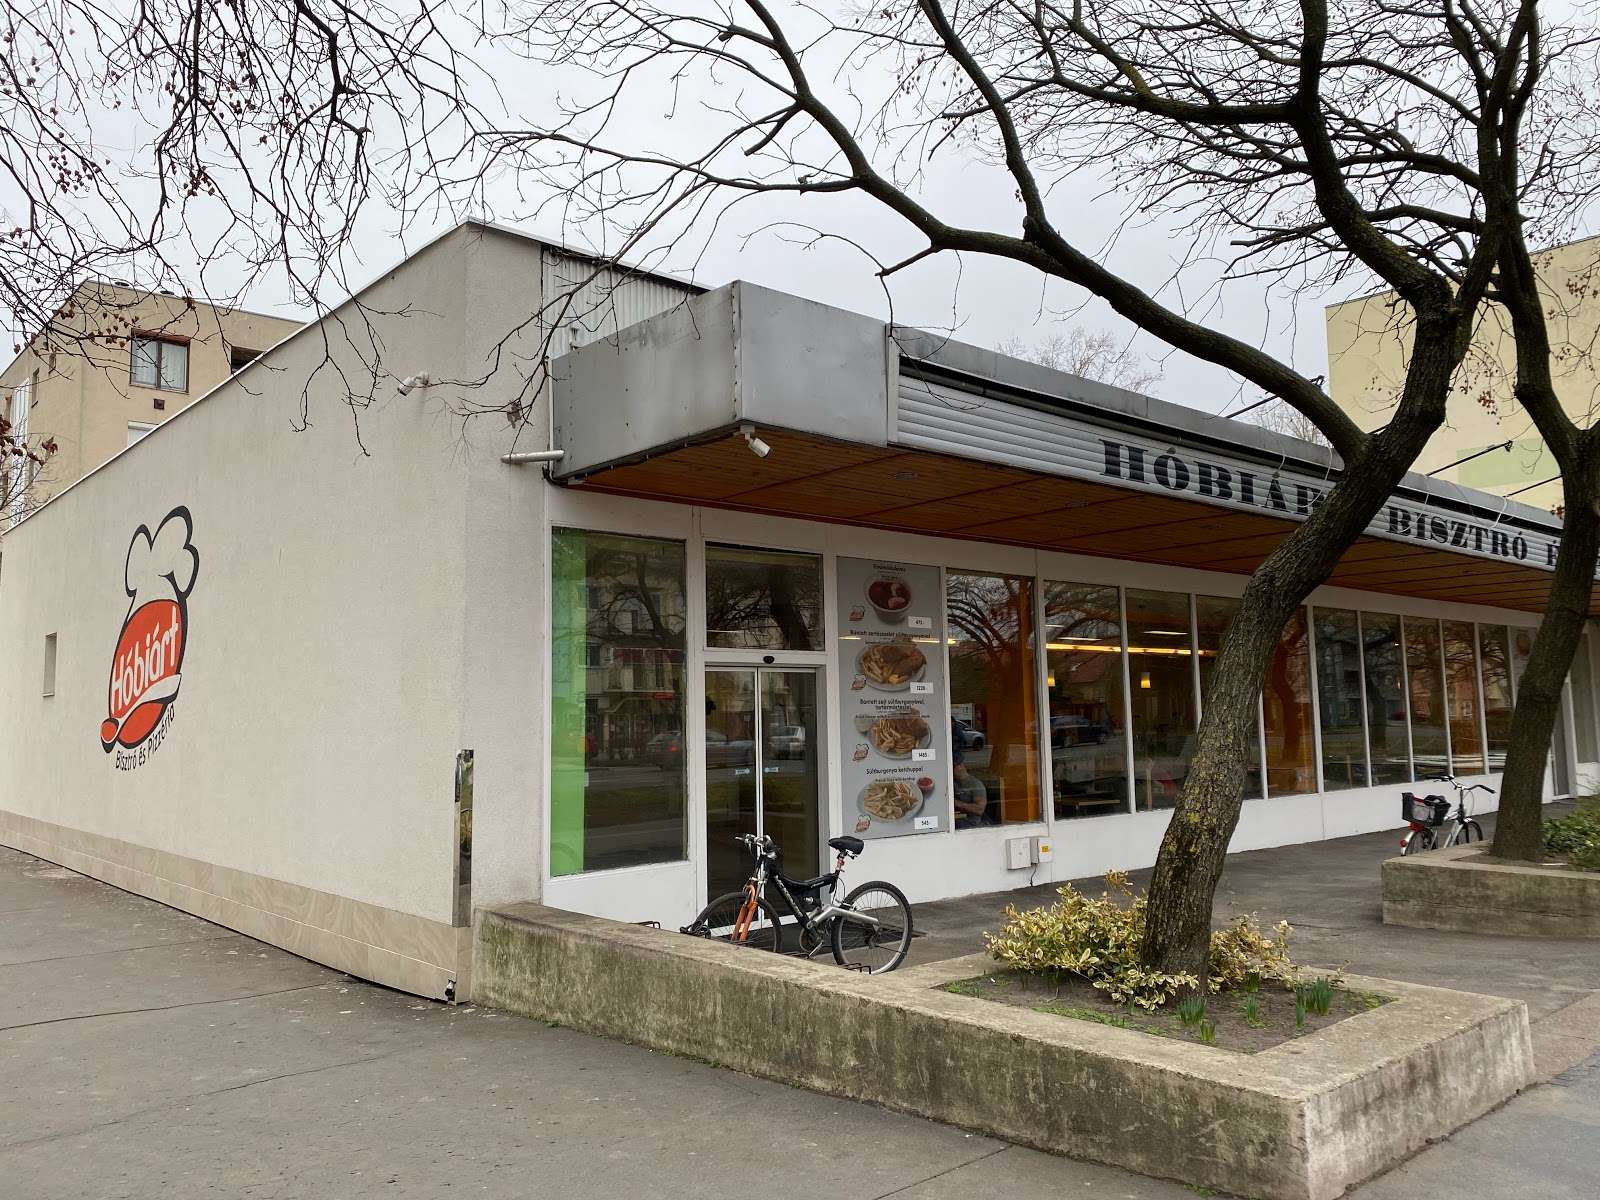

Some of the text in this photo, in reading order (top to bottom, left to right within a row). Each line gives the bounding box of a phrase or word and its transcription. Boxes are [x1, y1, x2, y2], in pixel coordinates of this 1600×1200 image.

[1099, 439, 1327, 517] HÓBIÁR
[1386, 505, 1529, 560] BISZTRÓ
[111, 605, 179, 716] Hóbiárt
[115, 703, 175, 772] Bisztró és Pizzéria
